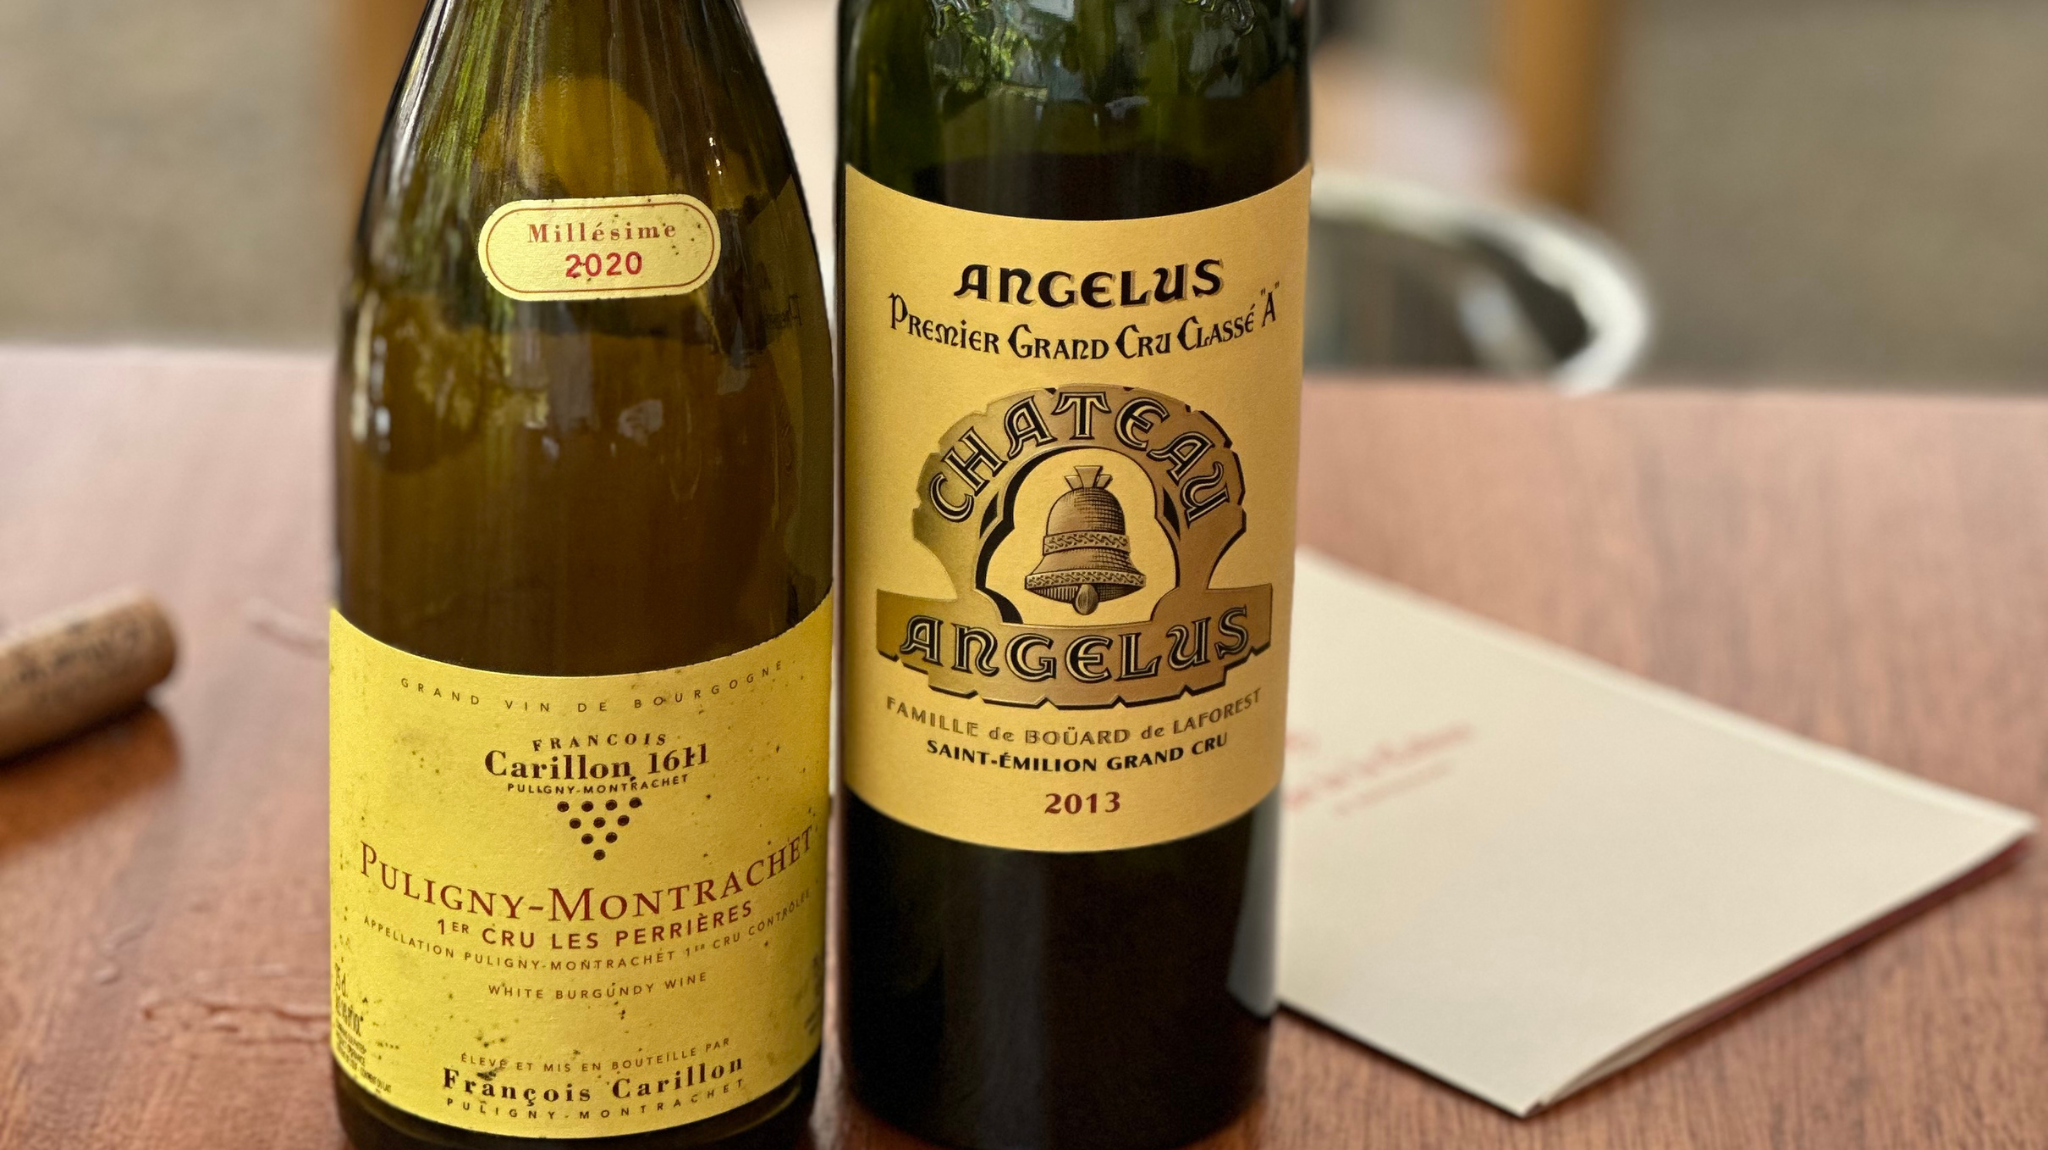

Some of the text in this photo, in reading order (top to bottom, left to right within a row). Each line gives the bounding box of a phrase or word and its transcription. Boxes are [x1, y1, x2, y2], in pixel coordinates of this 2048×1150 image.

[528, 220, 676, 244] Millésime
[565, 251, 642, 278] 2020
[953, 258, 1224, 309] ANGELUS
[887, 291, 1001, 356] PREMIER
[1008, 323, 1110, 361] GRAND
[1115, 323, 1171, 360] CRU
[1176, 303, 1257, 351] CLASSÉ
[900, 604, 1250, 683] ANGELUS
[400, 660, 784, 713] GRAND VIN DE BOURGOGNE
[886, 687, 1262, 747] FAMILLE de BOÜARD de LAFOREST
[485, 750, 632, 781] Carillon
[926, 732, 1229, 772] SAINT-ÉMILION GRAND CRU
[506, 773, 690, 794] PULIGNY-MONTRACHET
[1044, 791, 1121, 815] 2013
[360, 825, 813, 922] PULIGNY-MONTRACHET
[363, 916, 455, 959] APPELLATION
[463, 950, 676, 971] PULIGNY-MONTRACHET
[712, 932, 742, 950] CRU
[482, 925, 535, 949] CRU
[551, 931, 599, 949] LES
[615, 900, 752, 947] PERRIÈRES
[488, 971, 709, 1001] WHITE BURGUNDY WINE
[515, 1061, 533, 1072] ET
[542, 1062, 572, 1073] MIS
[580, 1060, 602, 1072] EN
[611, 1046, 698, 1071] BOUTEILLE
[705, 1036, 731, 1052] PAR
[442, 1066, 592, 1107] François
[612, 1056, 745, 1100] Carillon
[446, 1077, 746, 1120] PULIGNY-MONTRACHET
